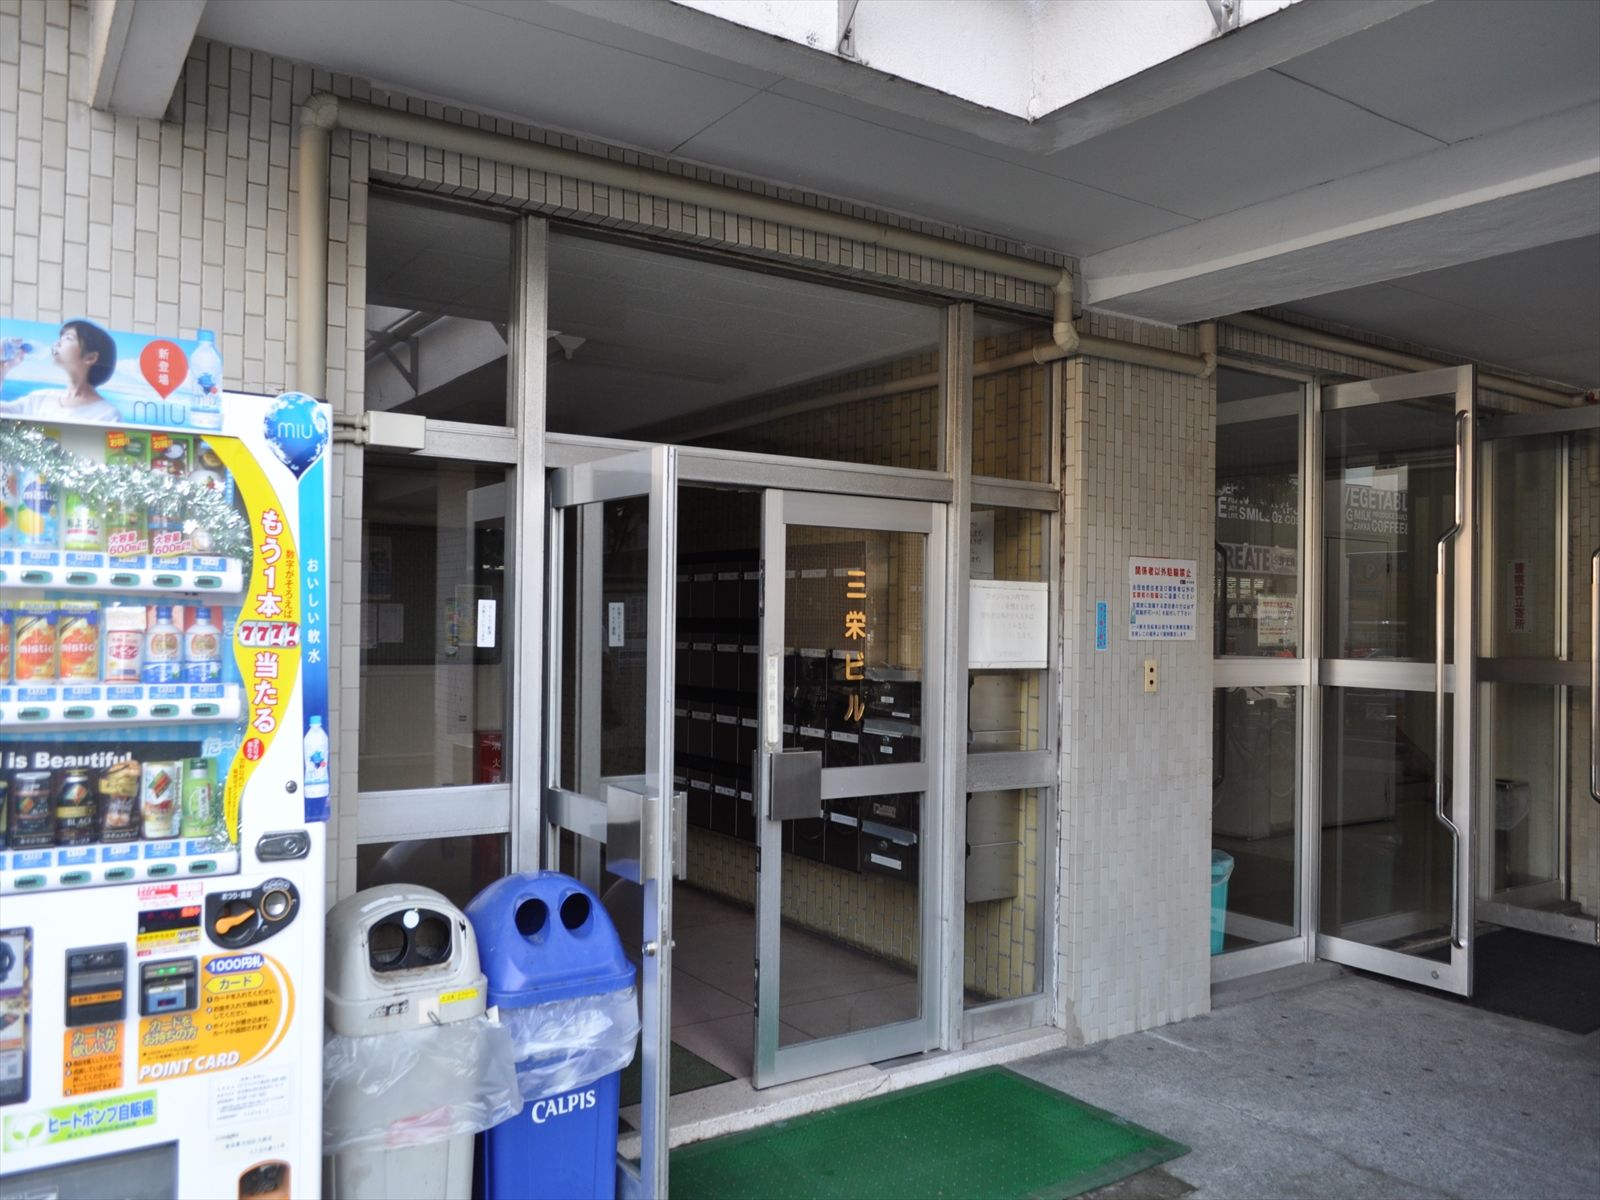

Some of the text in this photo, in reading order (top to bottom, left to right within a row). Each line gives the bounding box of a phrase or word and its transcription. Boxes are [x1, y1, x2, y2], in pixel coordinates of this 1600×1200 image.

[158, 348, 169, 385] 新登場
[255, 508, 283, 618] もう1本
[307, 559, 320, 663] おいしい軟水
[844, 570, 867, 722] 三栄ビル
[253, 651, 279, 734] 当たる
[9, 751, 28, 769] is
[208, 954, 264, 973] 1000円札
[219, 975, 252, 990] カード
[140, 1058, 192, 1080] POINT
[195, 1051, 240, 1072] CARD
[48, 1099, 154, 1134] ヒートポンプ自販機
[531, 1089, 596, 1124] CALPIS
